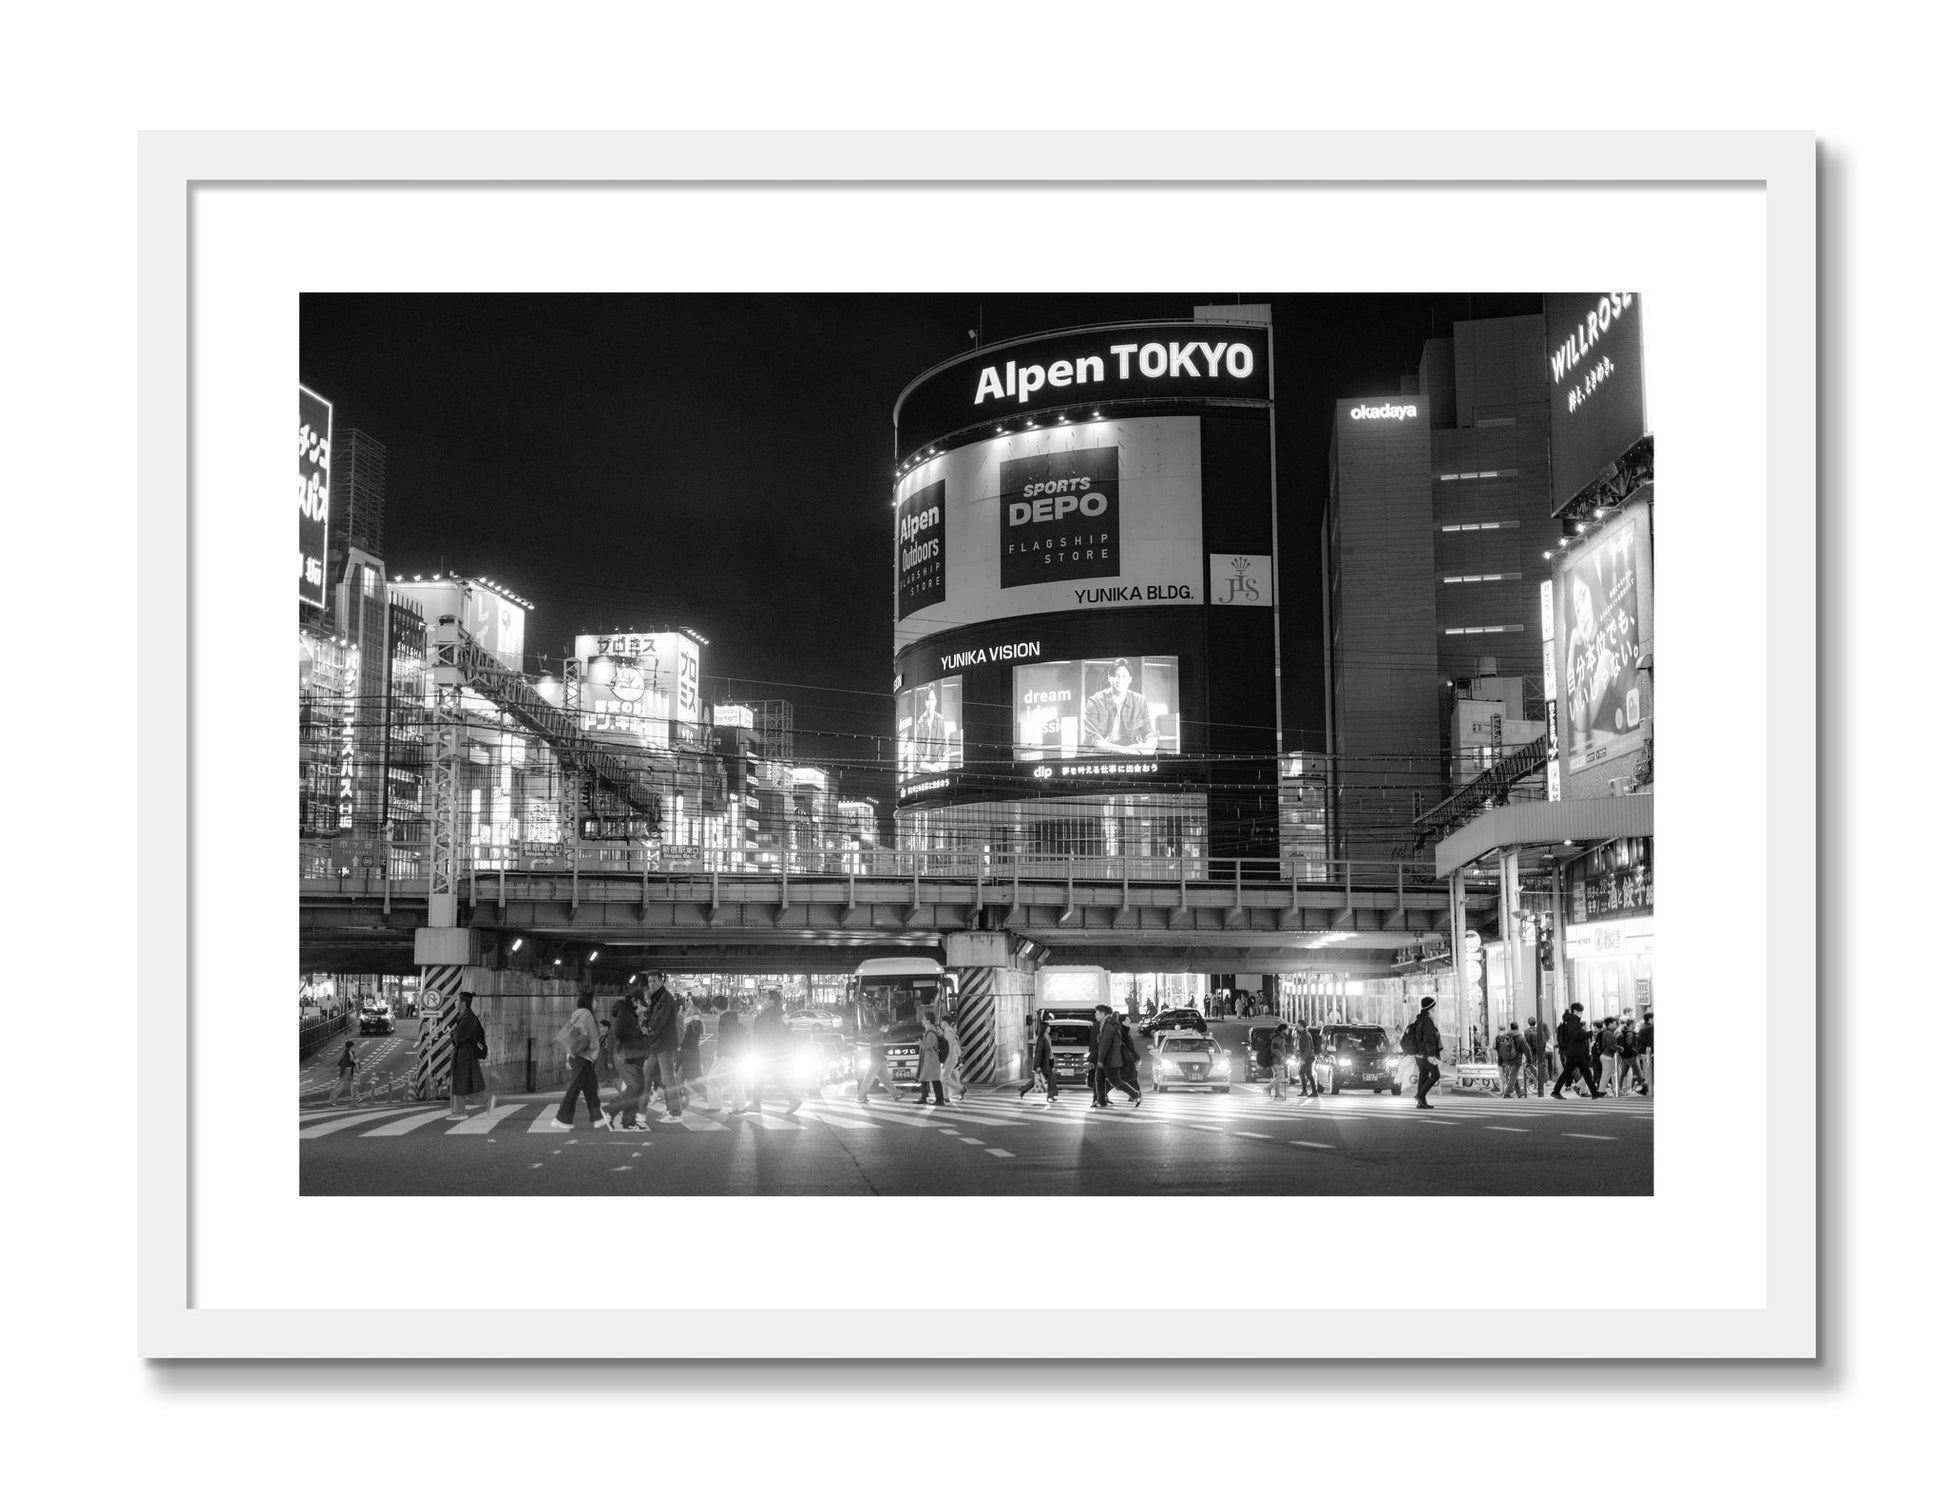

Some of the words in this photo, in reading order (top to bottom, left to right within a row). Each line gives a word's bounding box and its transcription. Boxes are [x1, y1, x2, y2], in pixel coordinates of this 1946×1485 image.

[974, 354, 1105, 405] Alpen
[1110, 341, 1255, 380] TOKYO
[1350, 403, 1418, 421] okadaya
[1023, 477, 1092, 497] SPORTS
[1008, 492, 1108, 527] DEPO
[899, 504, 940, 545] Alpen
[1008, 533, 1109, 555] FLAGSHIP
[902, 536, 940, 573] Outdoors
[1044, 549, 1109, 564] STORE
[910, 577, 941, 598] STORE
[1074, 586, 1143, 604] YUNIKA
[1146, 584, 1195, 600] BLDG.
[597, 636, 657, 655] プロミス
[940, 649, 987, 671] YUNIKA
[989, 641, 1041, 661] VISION
[1024, 688, 1072, 704] dream
[1033, 766, 1053, 779] dip
[1061, 763, 1159, 777] 夢を叶える仕事に出会おう
